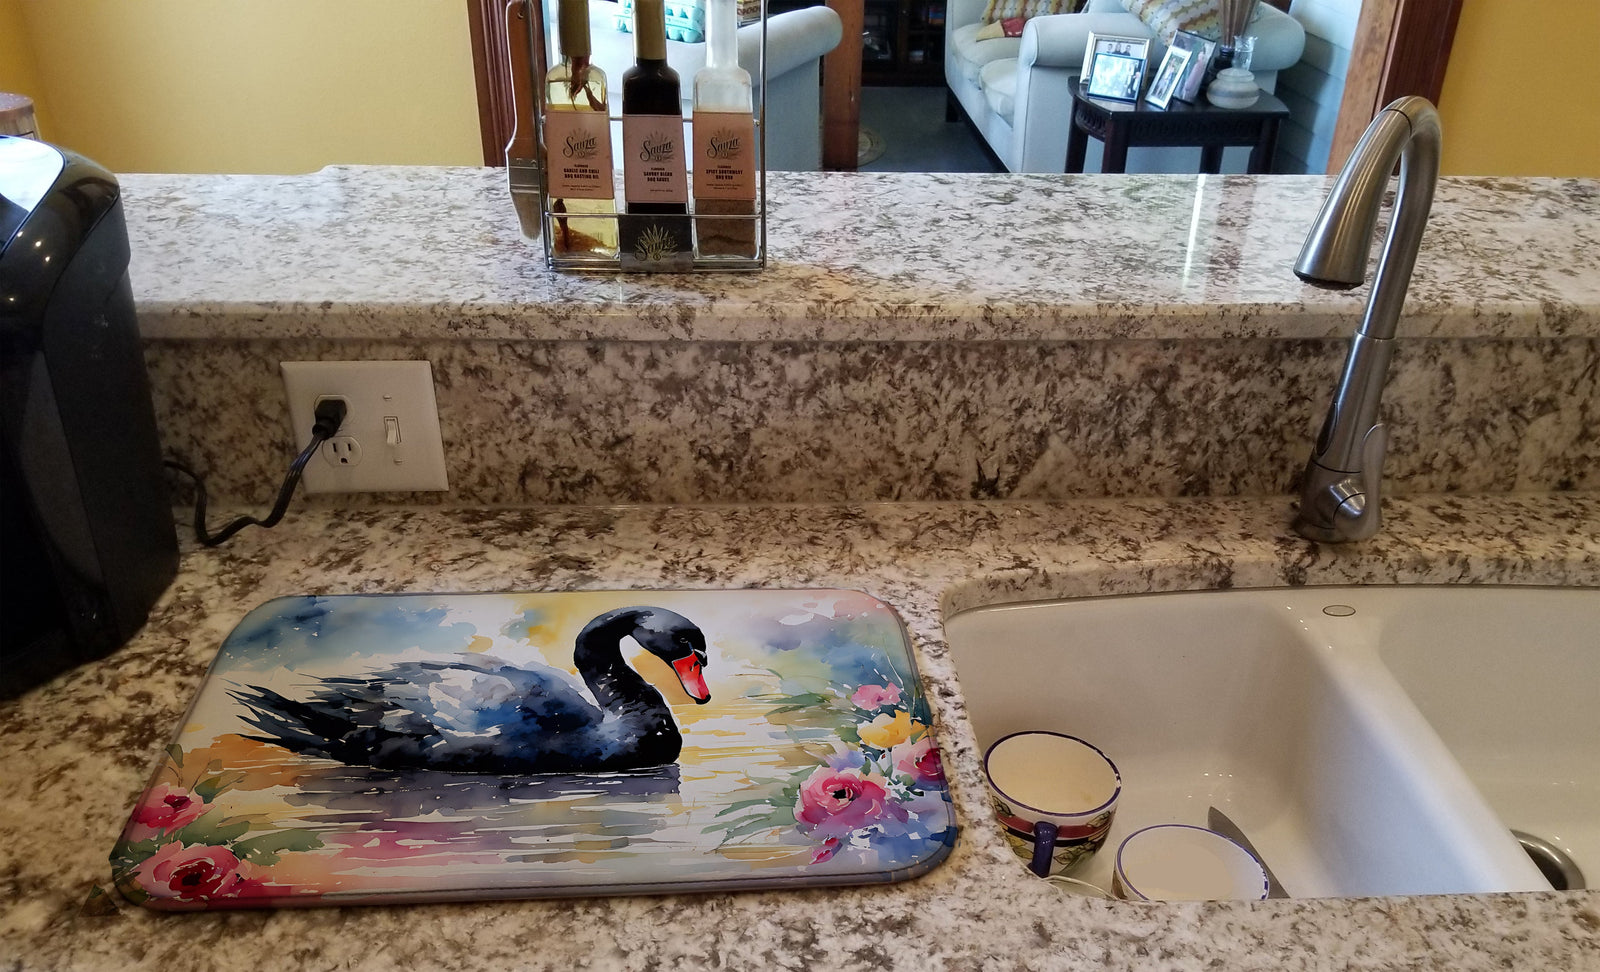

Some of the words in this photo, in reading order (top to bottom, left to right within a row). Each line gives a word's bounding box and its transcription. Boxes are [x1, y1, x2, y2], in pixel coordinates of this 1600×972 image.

[562, 136, 597, 158] Sauza
[640, 140, 673, 161] Sauza
[707, 137, 739, 158] Sauza
